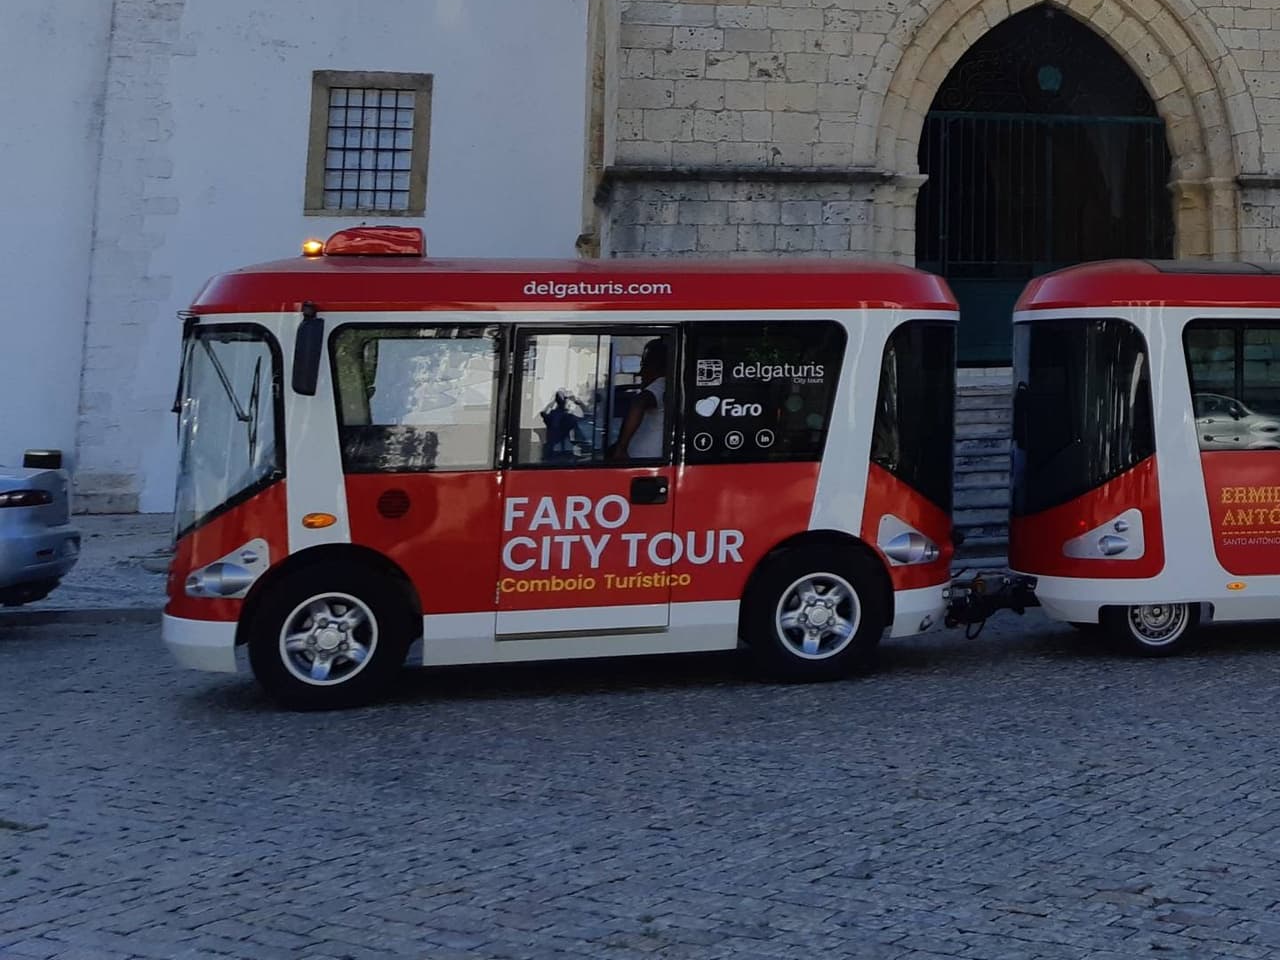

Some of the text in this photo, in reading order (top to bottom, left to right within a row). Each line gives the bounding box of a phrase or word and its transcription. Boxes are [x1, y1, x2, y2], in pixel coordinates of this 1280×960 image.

[523, 281, 672, 298] delgaturis.com
[732, 361, 824, 382] delgaturis
[721, 398, 762, 417] Faro
[503, 494, 631, 532] FARO
[502, 529, 745, 572] CITY TOUR
[501, 571, 691, 593] Comboio Turístico
